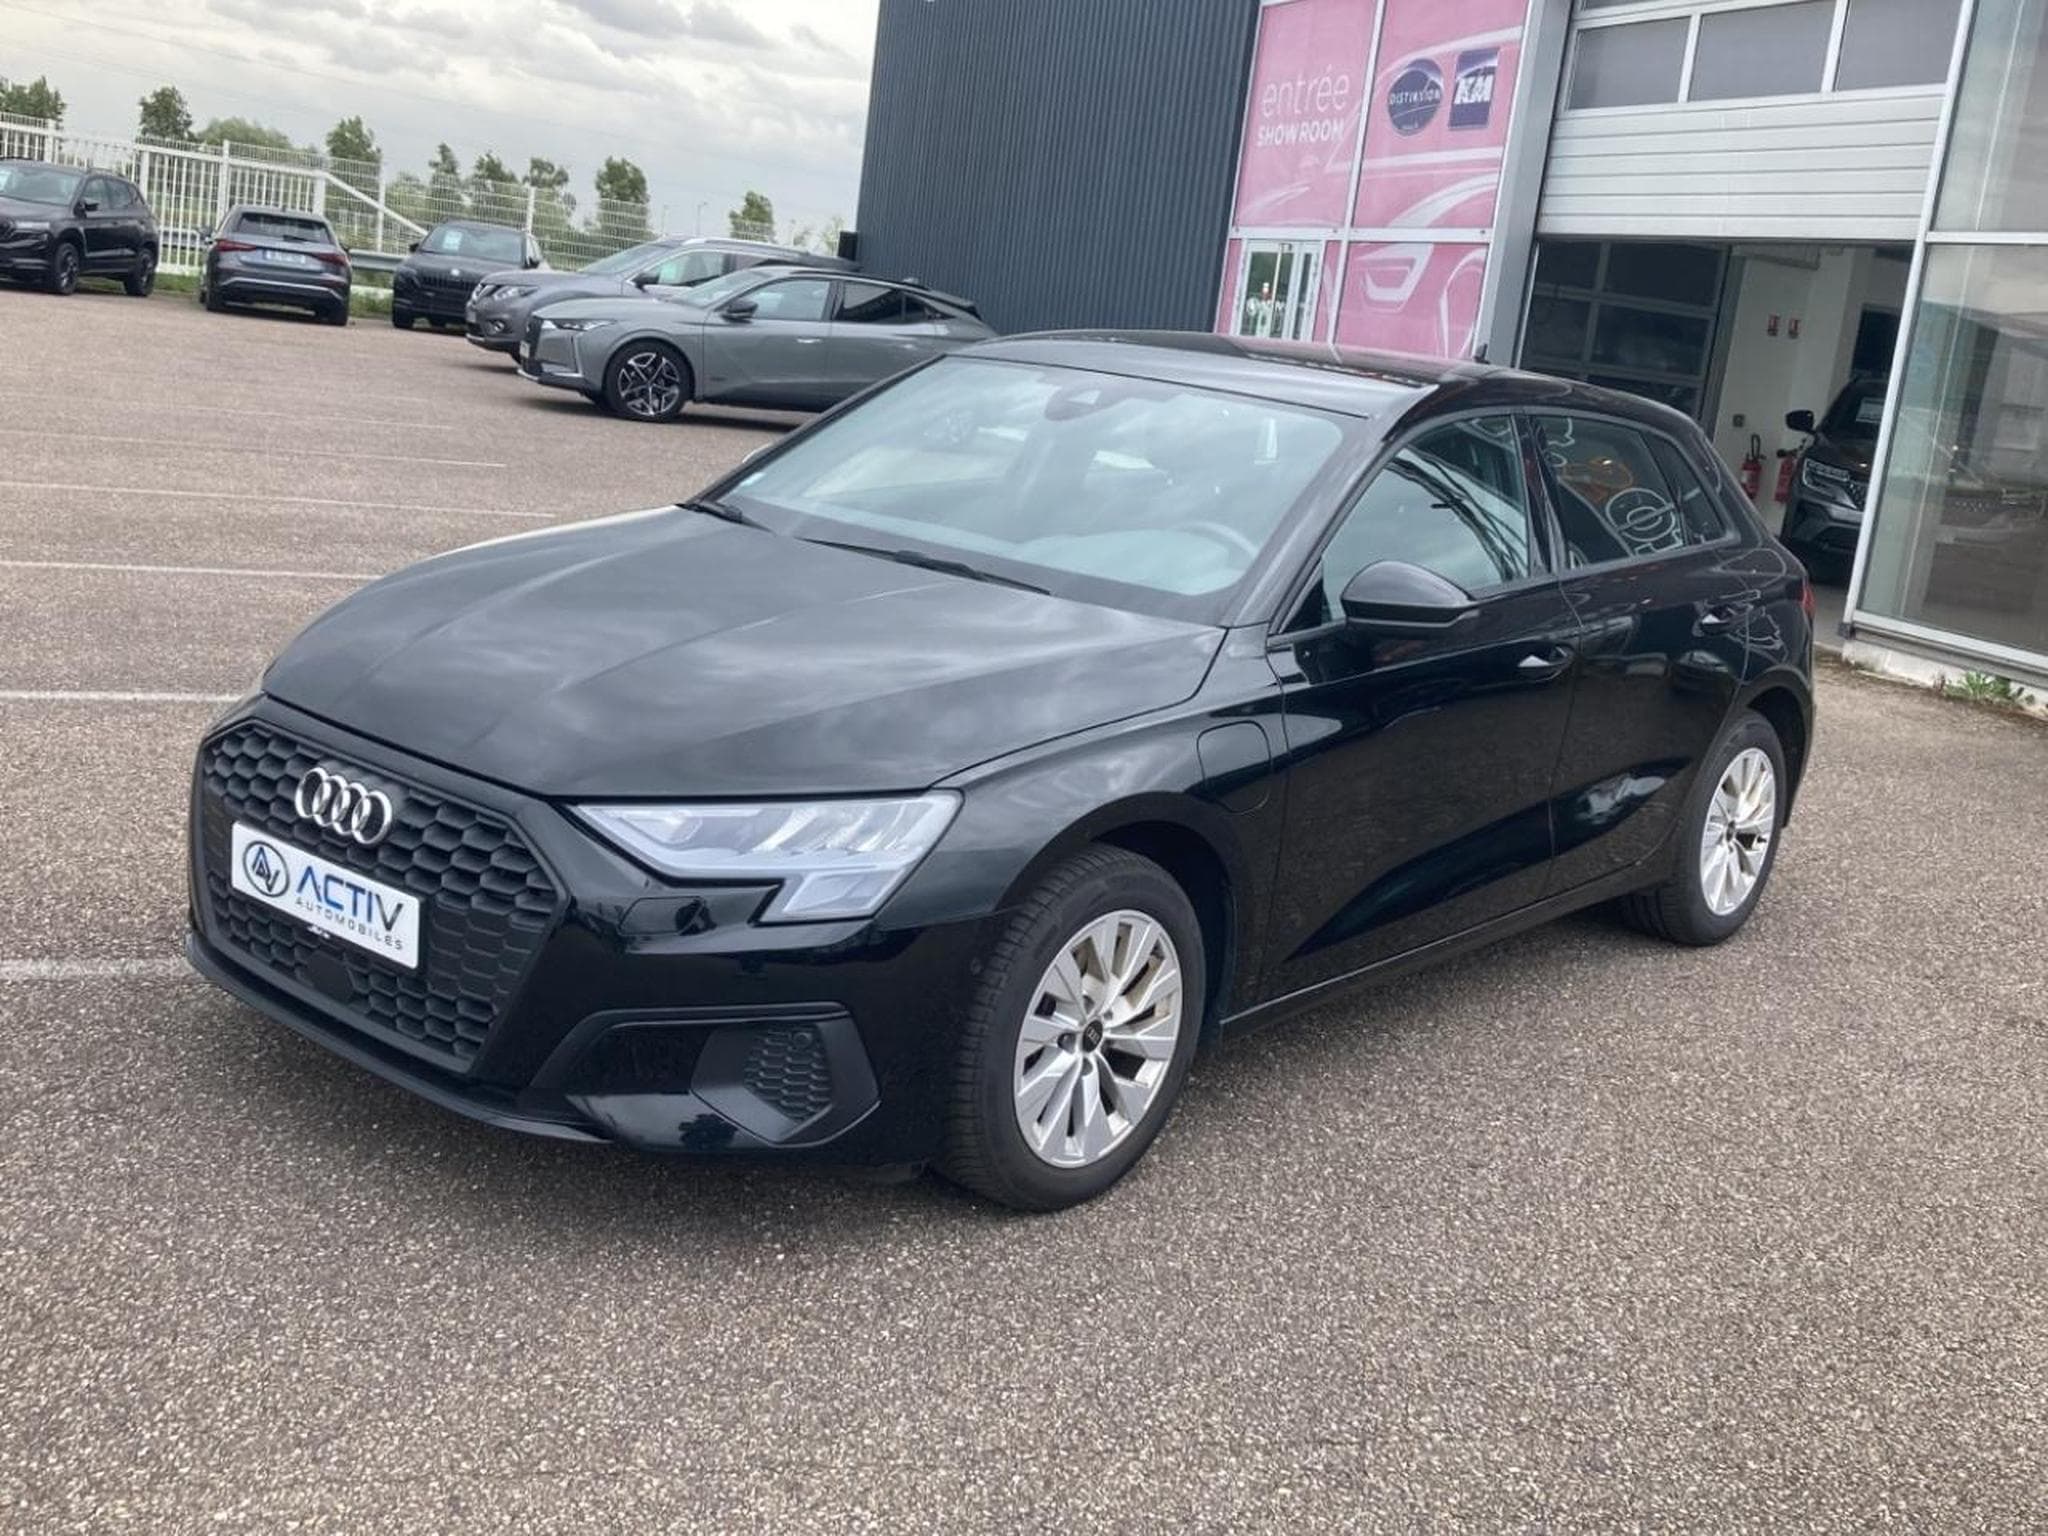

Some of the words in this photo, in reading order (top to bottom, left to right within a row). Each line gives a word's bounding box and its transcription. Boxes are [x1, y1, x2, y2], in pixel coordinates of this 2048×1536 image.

[1263, 64, 1349, 117] entrée
[1257, 119, 1345, 147] SHOWROOM
[295, 898, 404, 951] AUTOMOBILES
[297, 865, 404, 932] ACTIV
